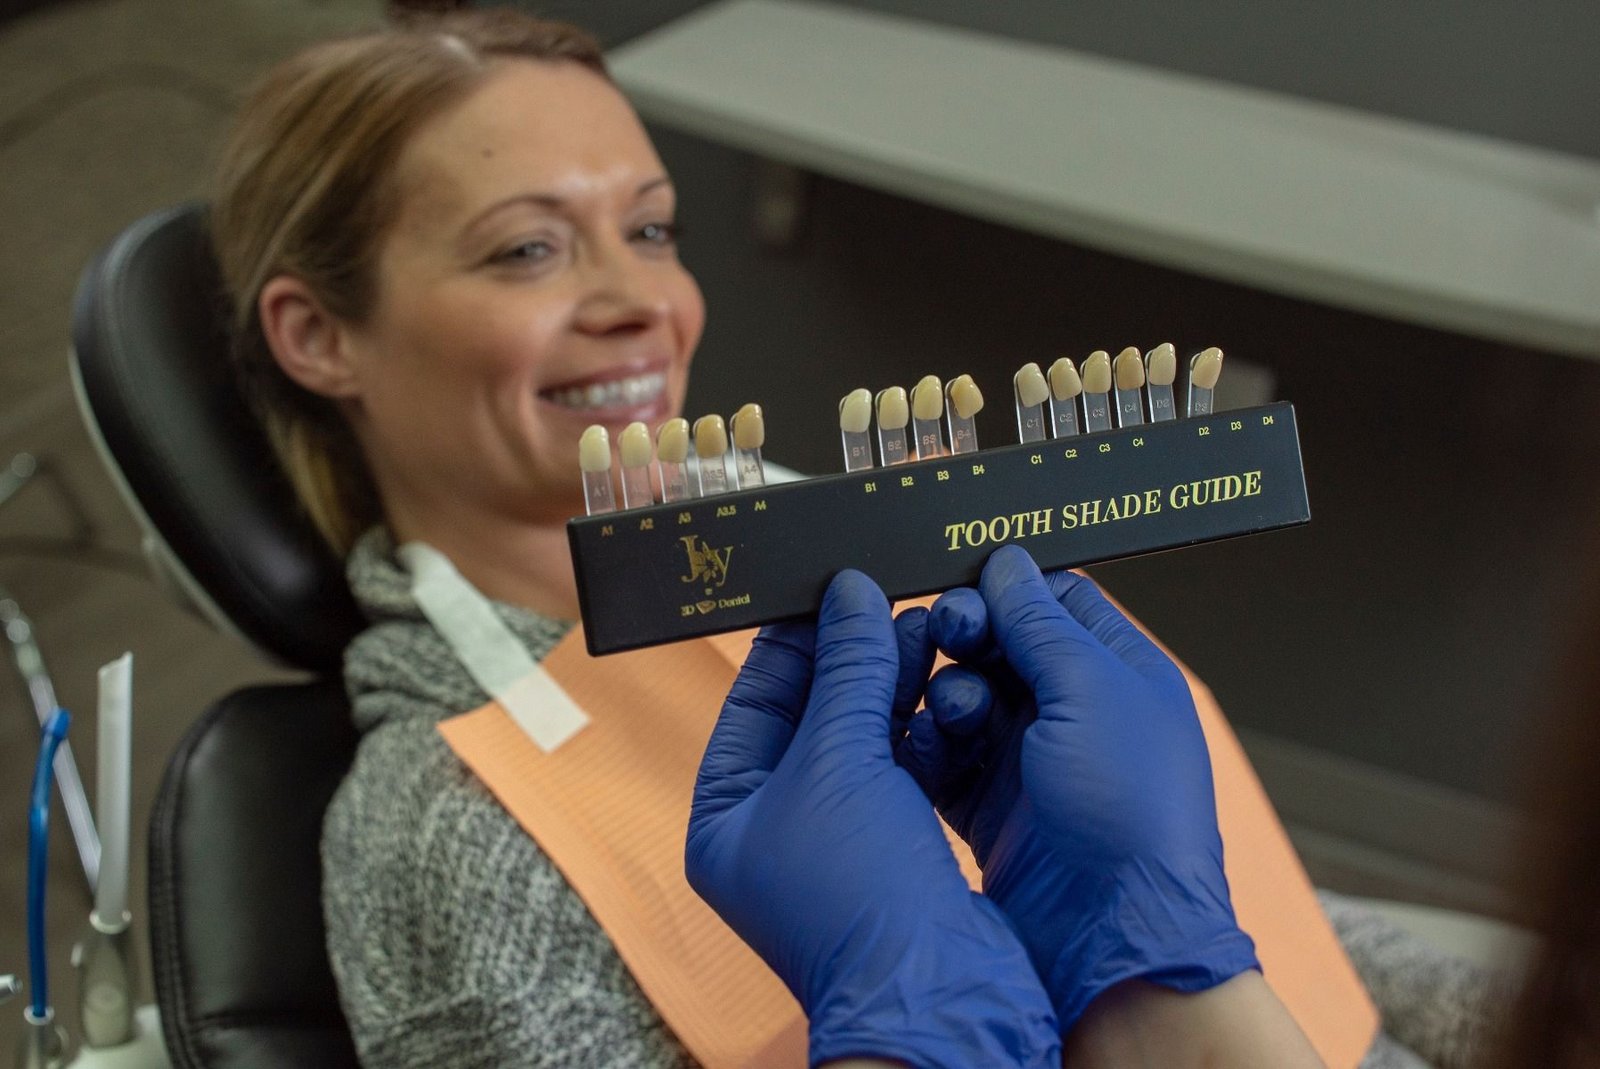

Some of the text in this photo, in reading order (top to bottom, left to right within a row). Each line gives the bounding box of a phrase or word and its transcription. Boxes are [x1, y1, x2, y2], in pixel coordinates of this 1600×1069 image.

[1026, 418, 1040, 428] C1
[1199, 416, 1274, 436] D2 D3 D4
[852, 446, 866, 457] B1
[1031, 438, 1144, 464] C1 C2 C3 C4
[865, 464, 985, 493] B1 B2 B3 B4
[601, 500, 767, 536] A1 A2 A3 A3.5 A4
[945, 470, 1262, 550] TOOTH SHADE GUIDE
